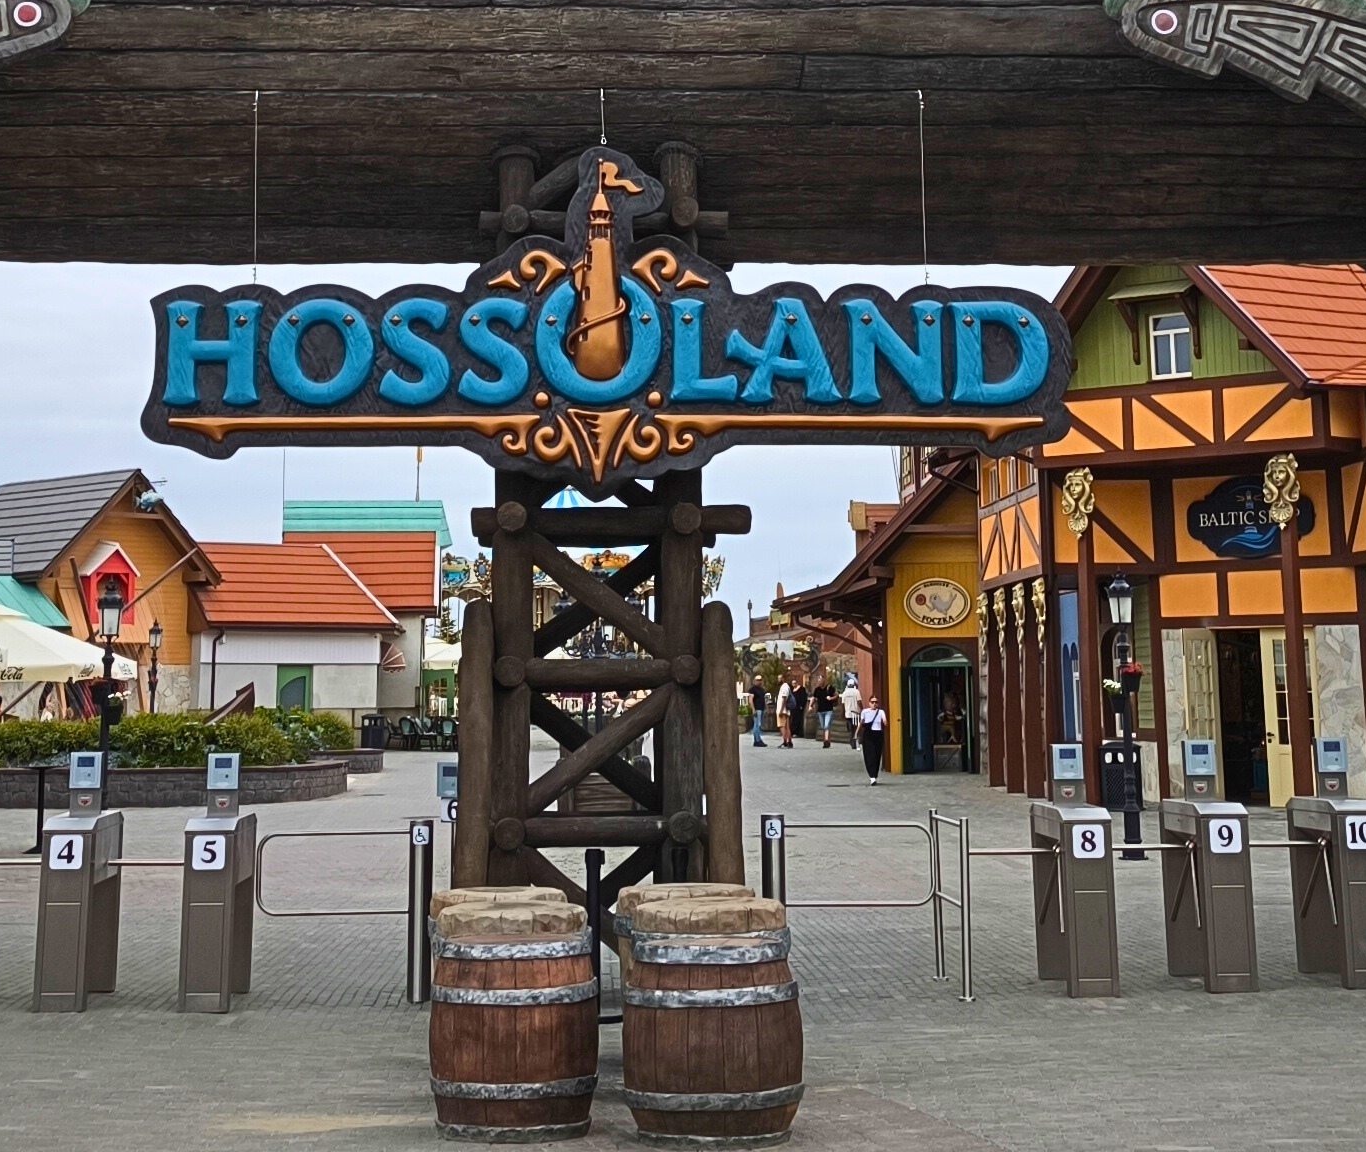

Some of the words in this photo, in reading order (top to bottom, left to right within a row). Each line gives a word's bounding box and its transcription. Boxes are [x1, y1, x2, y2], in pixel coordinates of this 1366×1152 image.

[163, 279, 1051, 405] HOSSOLAND
[1199, 510, 1255, 527] BALTIC
[447, 798, 459, 820] 6
[1080, 829, 1097, 853] 8
[1217, 824, 1234, 848] 9
[56, 839, 75, 865] 4
[200, 840, 217, 864] 5
